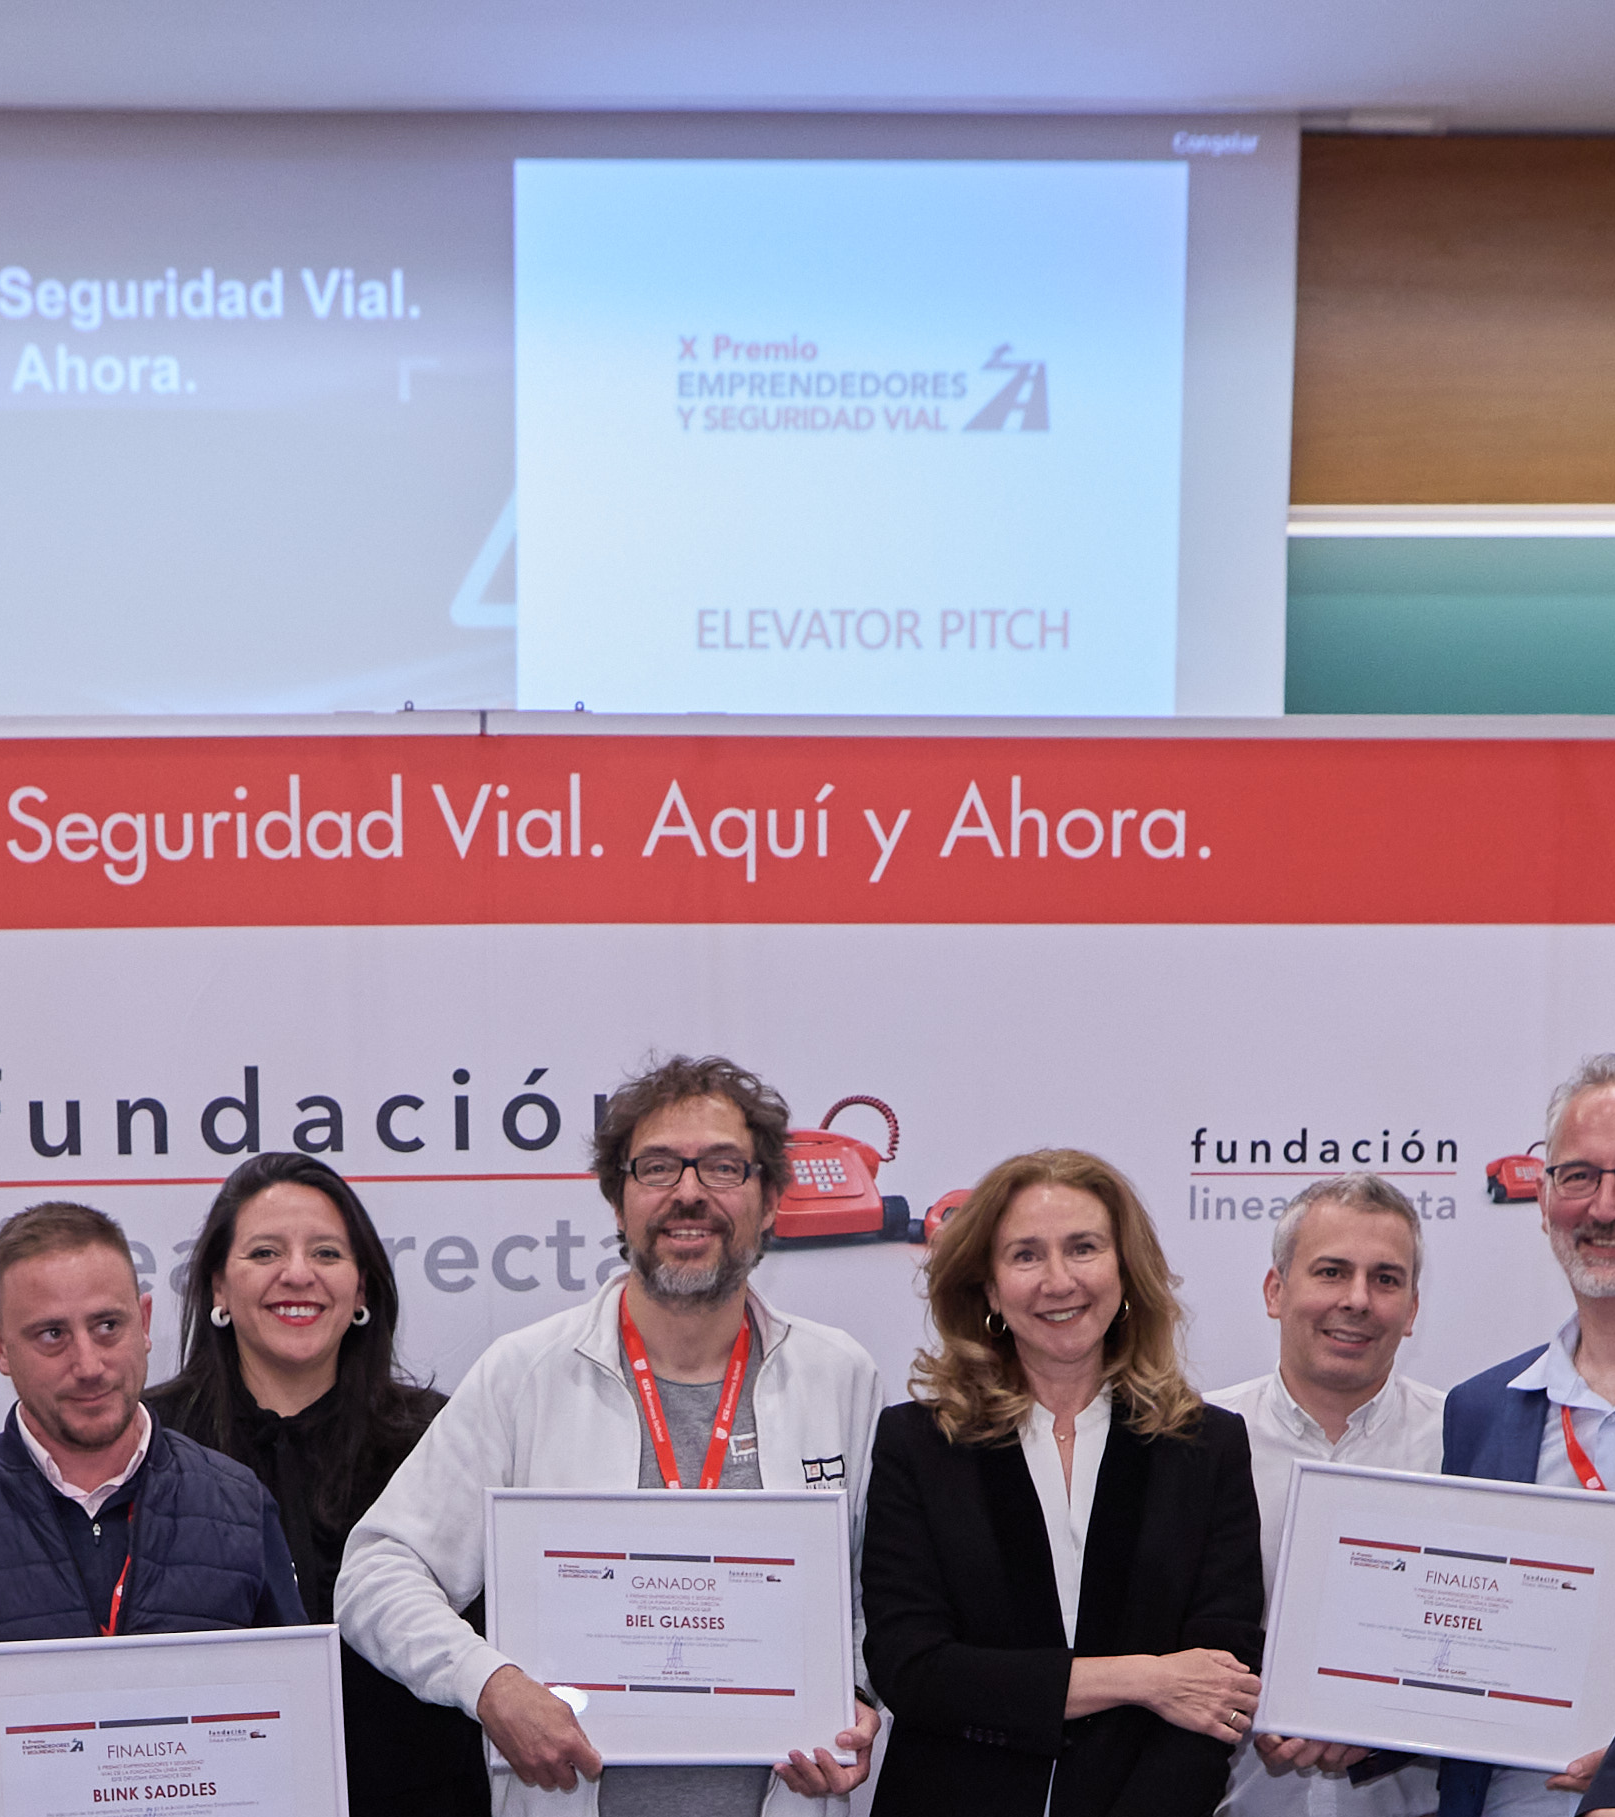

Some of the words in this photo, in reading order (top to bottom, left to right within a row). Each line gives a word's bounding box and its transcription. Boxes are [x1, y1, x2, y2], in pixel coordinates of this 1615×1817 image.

[301, 268, 421, 319] Vial.
[679, 336, 696, 361] X
[713, 335, 818, 361] Premio
[12, 342, 198, 394] Ahora.
[678, 371, 967, 399] EMPRENDEDORES
[678, 406, 694, 432] Y
[704, 406, 875, 432] SEGURIDAD
[884, 406, 948, 432] VIAL
[697, 609, 922, 650] ELEVATOR
[941, 609, 1070, 650] PITCH
[7, 774, 403, 885] Seguridad
[432, 773, 604, 860] Vial.
[642, 779, 835, 883] Aquí
[863, 809, 911, 883] y
[939, 776, 1212, 860] Ahora.
[1191, 1128, 1457, 1164] fundación
[632, 1576, 716, 1591] GANADOR
[1426, 1570, 1499, 1591] FINALISTA
[626, 1615, 654, 1627] BIEL
[660, 1616, 724, 1629] GLASSES
[1424, 1612, 1482, 1631] EVESTEL
[107, 1741, 187, 1759] FINALISTA
[93, 1787, 138, 1802] BLINK
[145, 1782, 217, 1800] SADDLES
